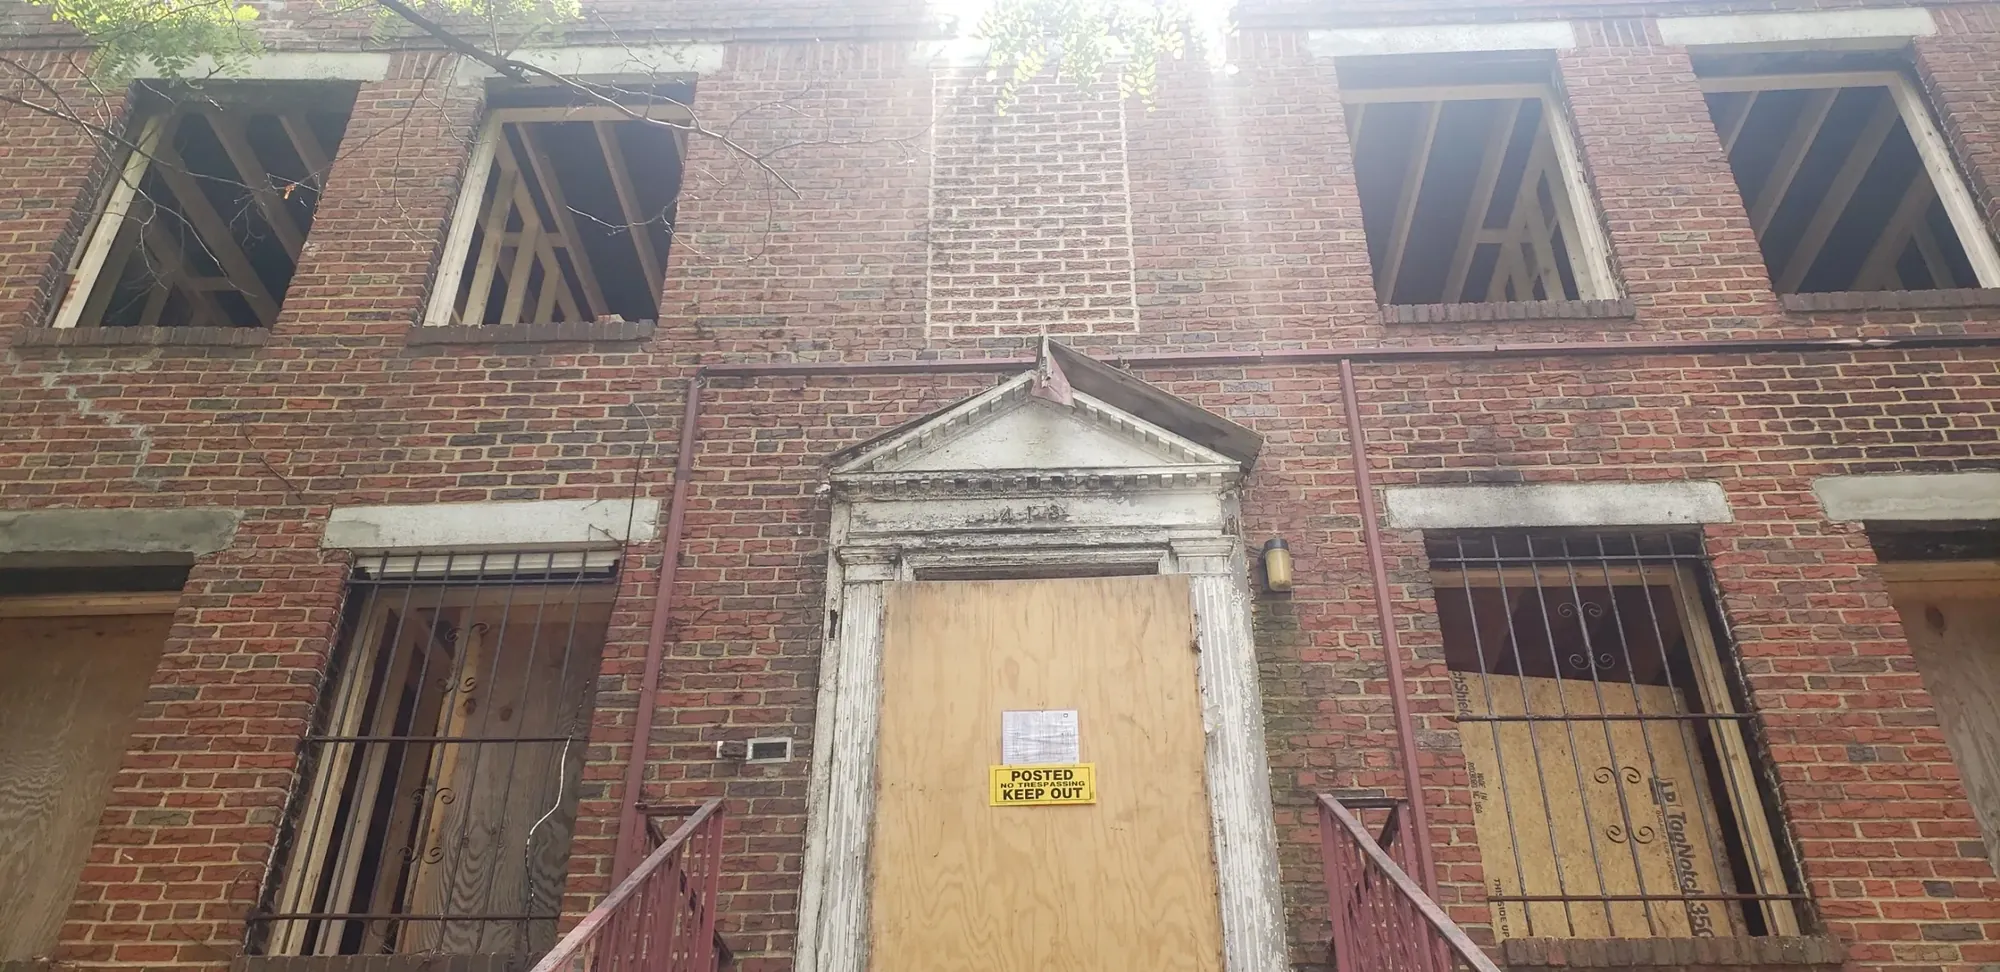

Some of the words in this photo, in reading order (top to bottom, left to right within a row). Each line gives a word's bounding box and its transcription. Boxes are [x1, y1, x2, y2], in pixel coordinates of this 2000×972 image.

[1011, 769, 1074, 781] POSTED
[1018, 780, 1086, 788] TRESPASSING
[1003, 788, 1045, 800] KEEP
[1050, 787, 1083, 799] OUT
[1497, 900, 1508, 922] SIDE
[1501, 924, 1510, 938] UP
